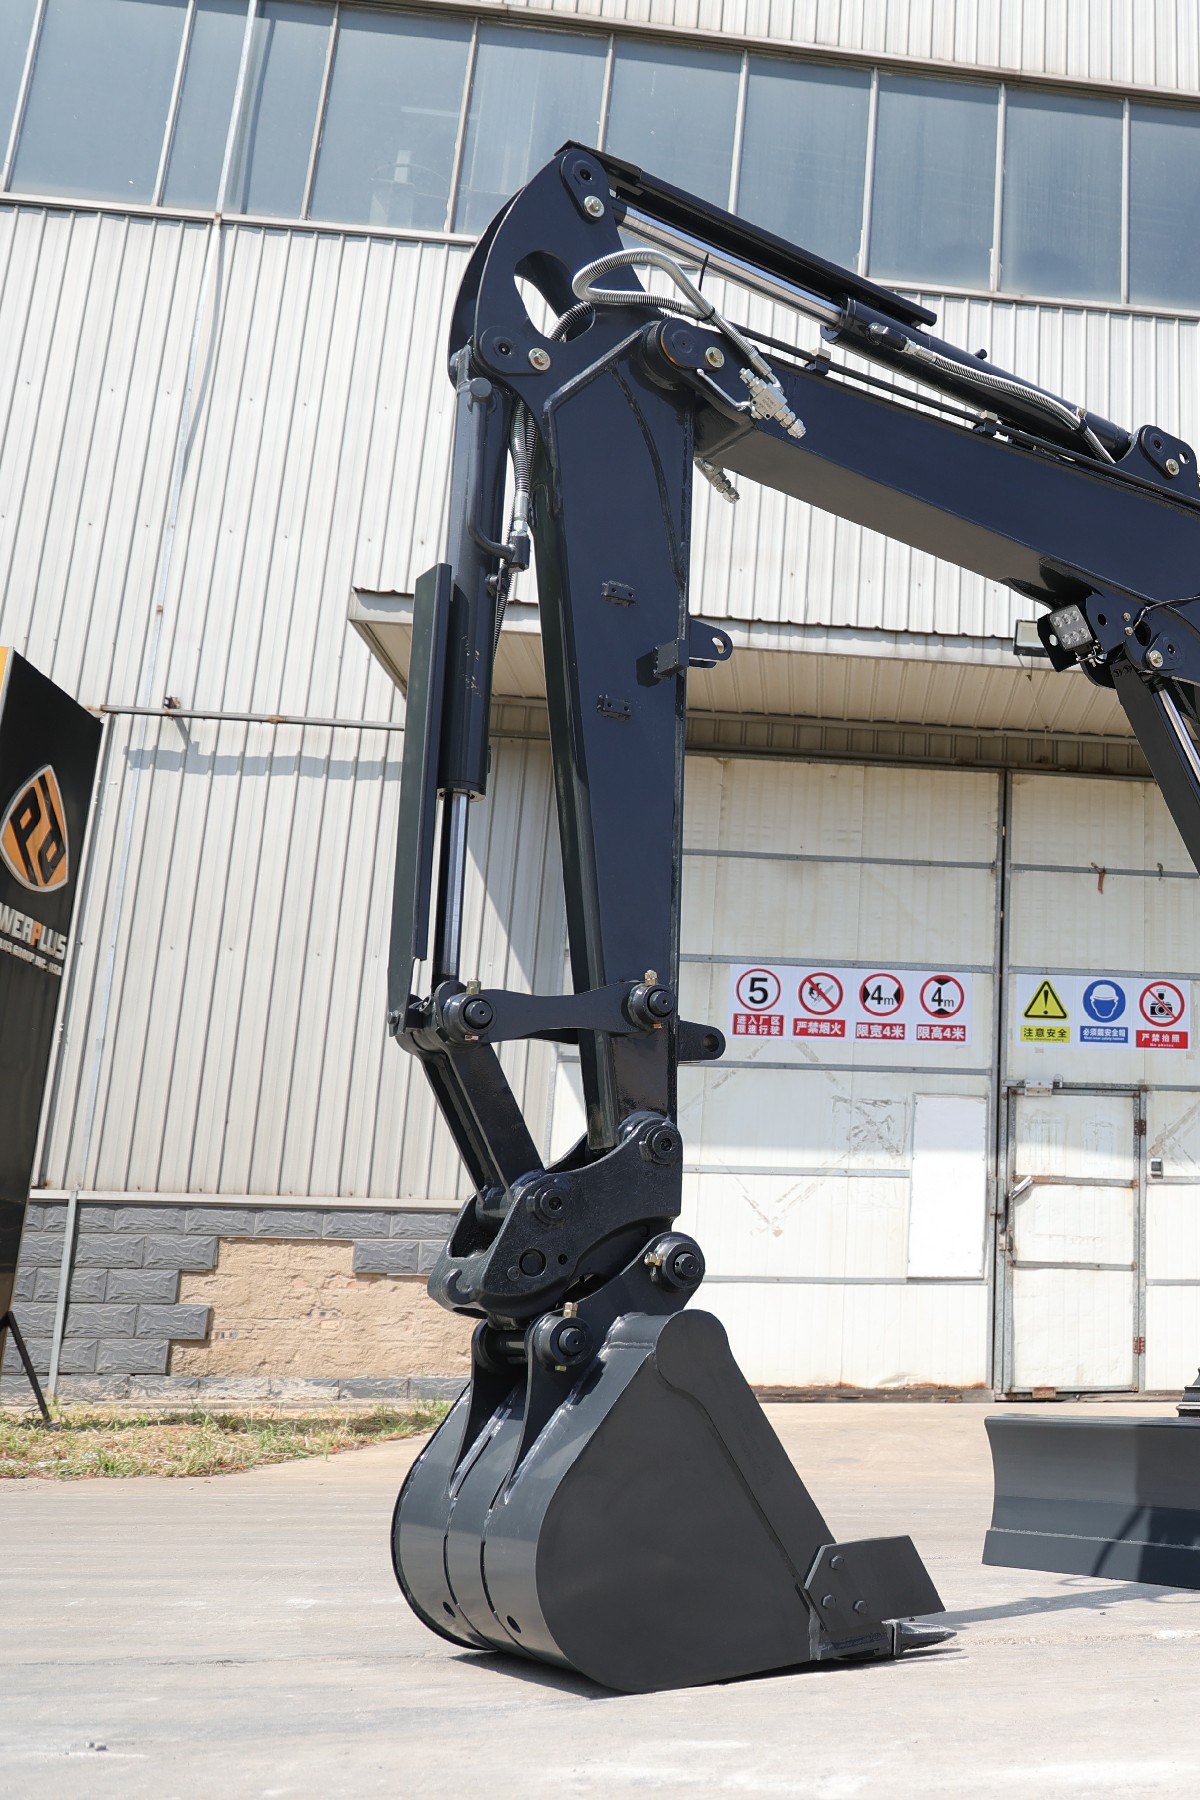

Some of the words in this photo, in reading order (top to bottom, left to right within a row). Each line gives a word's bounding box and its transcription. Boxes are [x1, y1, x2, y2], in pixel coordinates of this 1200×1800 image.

[748, 977, 769, 1005] 5
[870, 984, 895, 1006] 4m
[931, 986, 955, 1008] 4m
[736, 1015, 780, 1025] 进入厂区
[796, 1020, 842, 1035] 严禁烟火
[856, 1024, 904, 1037] 限宽4米
[917, 1026, 964, 1039] 限高4米
[1023, 1027, 1067, 1038] 注意安全
[1141, 1033, 1180, 1043] 严禁拍照
